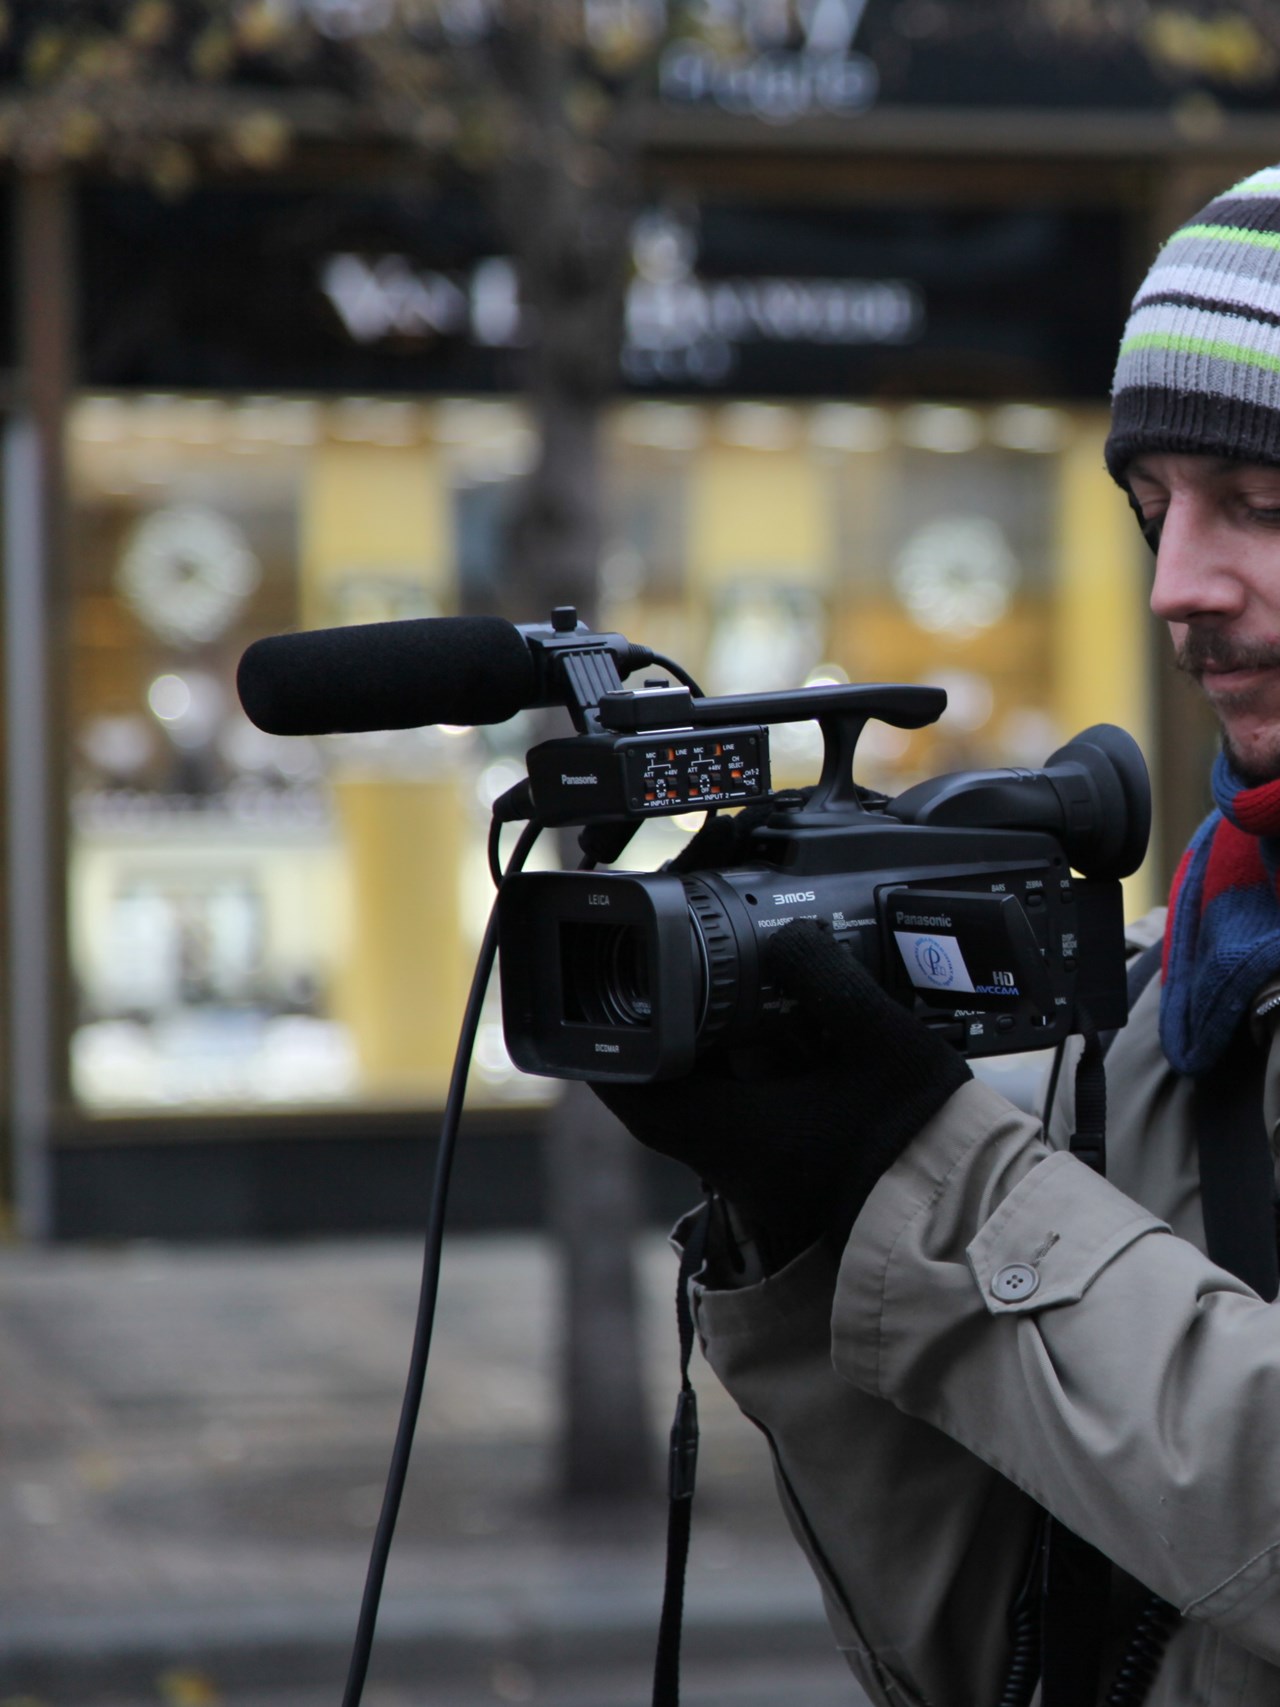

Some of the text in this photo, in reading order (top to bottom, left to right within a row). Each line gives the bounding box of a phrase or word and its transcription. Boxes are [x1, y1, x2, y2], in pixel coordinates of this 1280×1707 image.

[693, 746, 704, 754] MIC
[722, 743, 735, 751] LINE
[675, 748, 688, 756] LINE
[727, 761, 744, 769] SELECT
[687, 766, 698, 774] ATT
[561, 774, 598, 785] Panasonic
[704, 792, 724, 801] INPUT
[650, 799, 670, 807] INPUT
[991, 884, 1006, 892] BARS
[1025, 880, 1043, 889] ZEBRA
[588, 894, 610, 906] LEICA
[758, 919, 777, 928] FOCUS
[896, 911, 952, 928] Panasonic
[992, 971, 1015, 986] HD
[975, 985, 1019, 995] AVCCAM
[595, 1043, 620, 1053] DICOMAR
